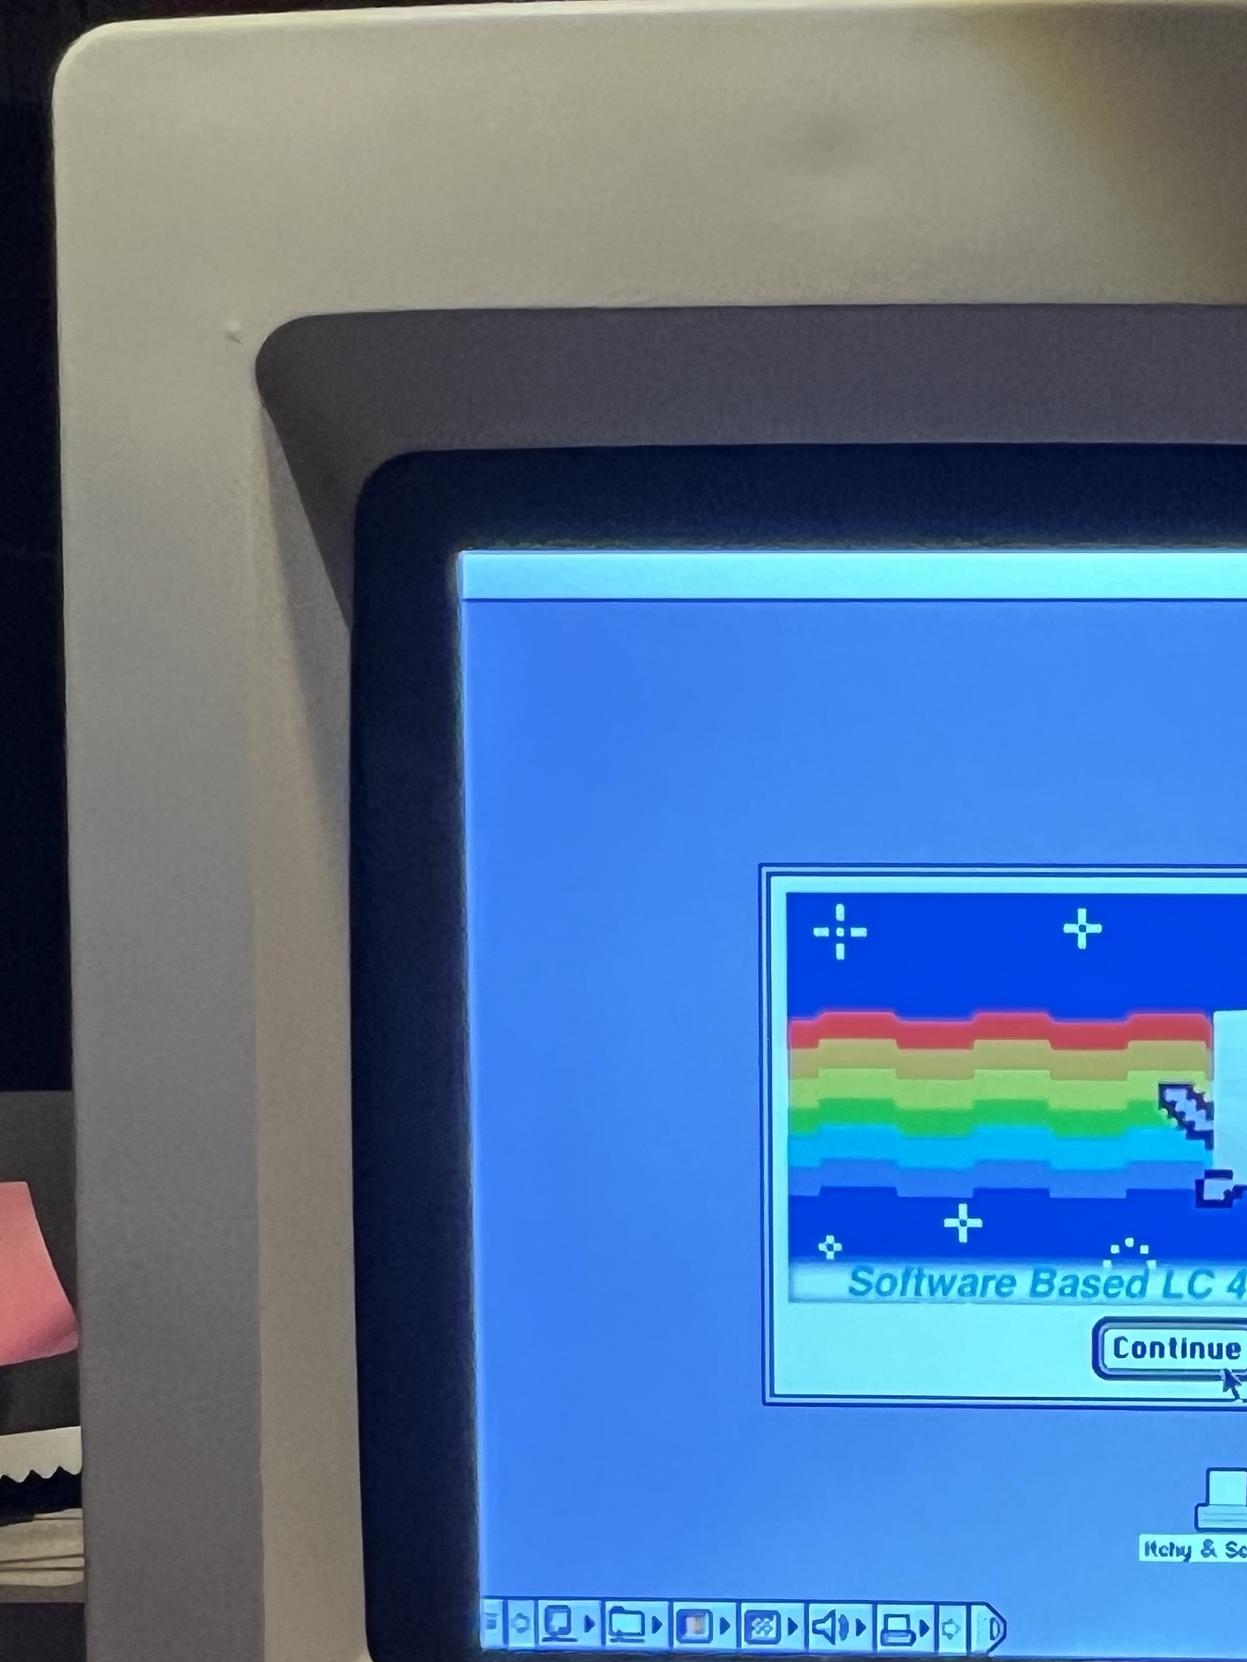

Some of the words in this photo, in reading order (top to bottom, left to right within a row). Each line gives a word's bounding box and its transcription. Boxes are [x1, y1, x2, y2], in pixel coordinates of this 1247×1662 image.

[848, 1265, 1016, 1301] Software
[1028, 1268, 1149, 1302] Based
[1161, 1271, 1214, 1301] LC
[1112, 1335, 1242, 1362] Continue
[1144, 1540, 1192, 1563] Itchy
[1200, 1538, 1218, 1559] &
